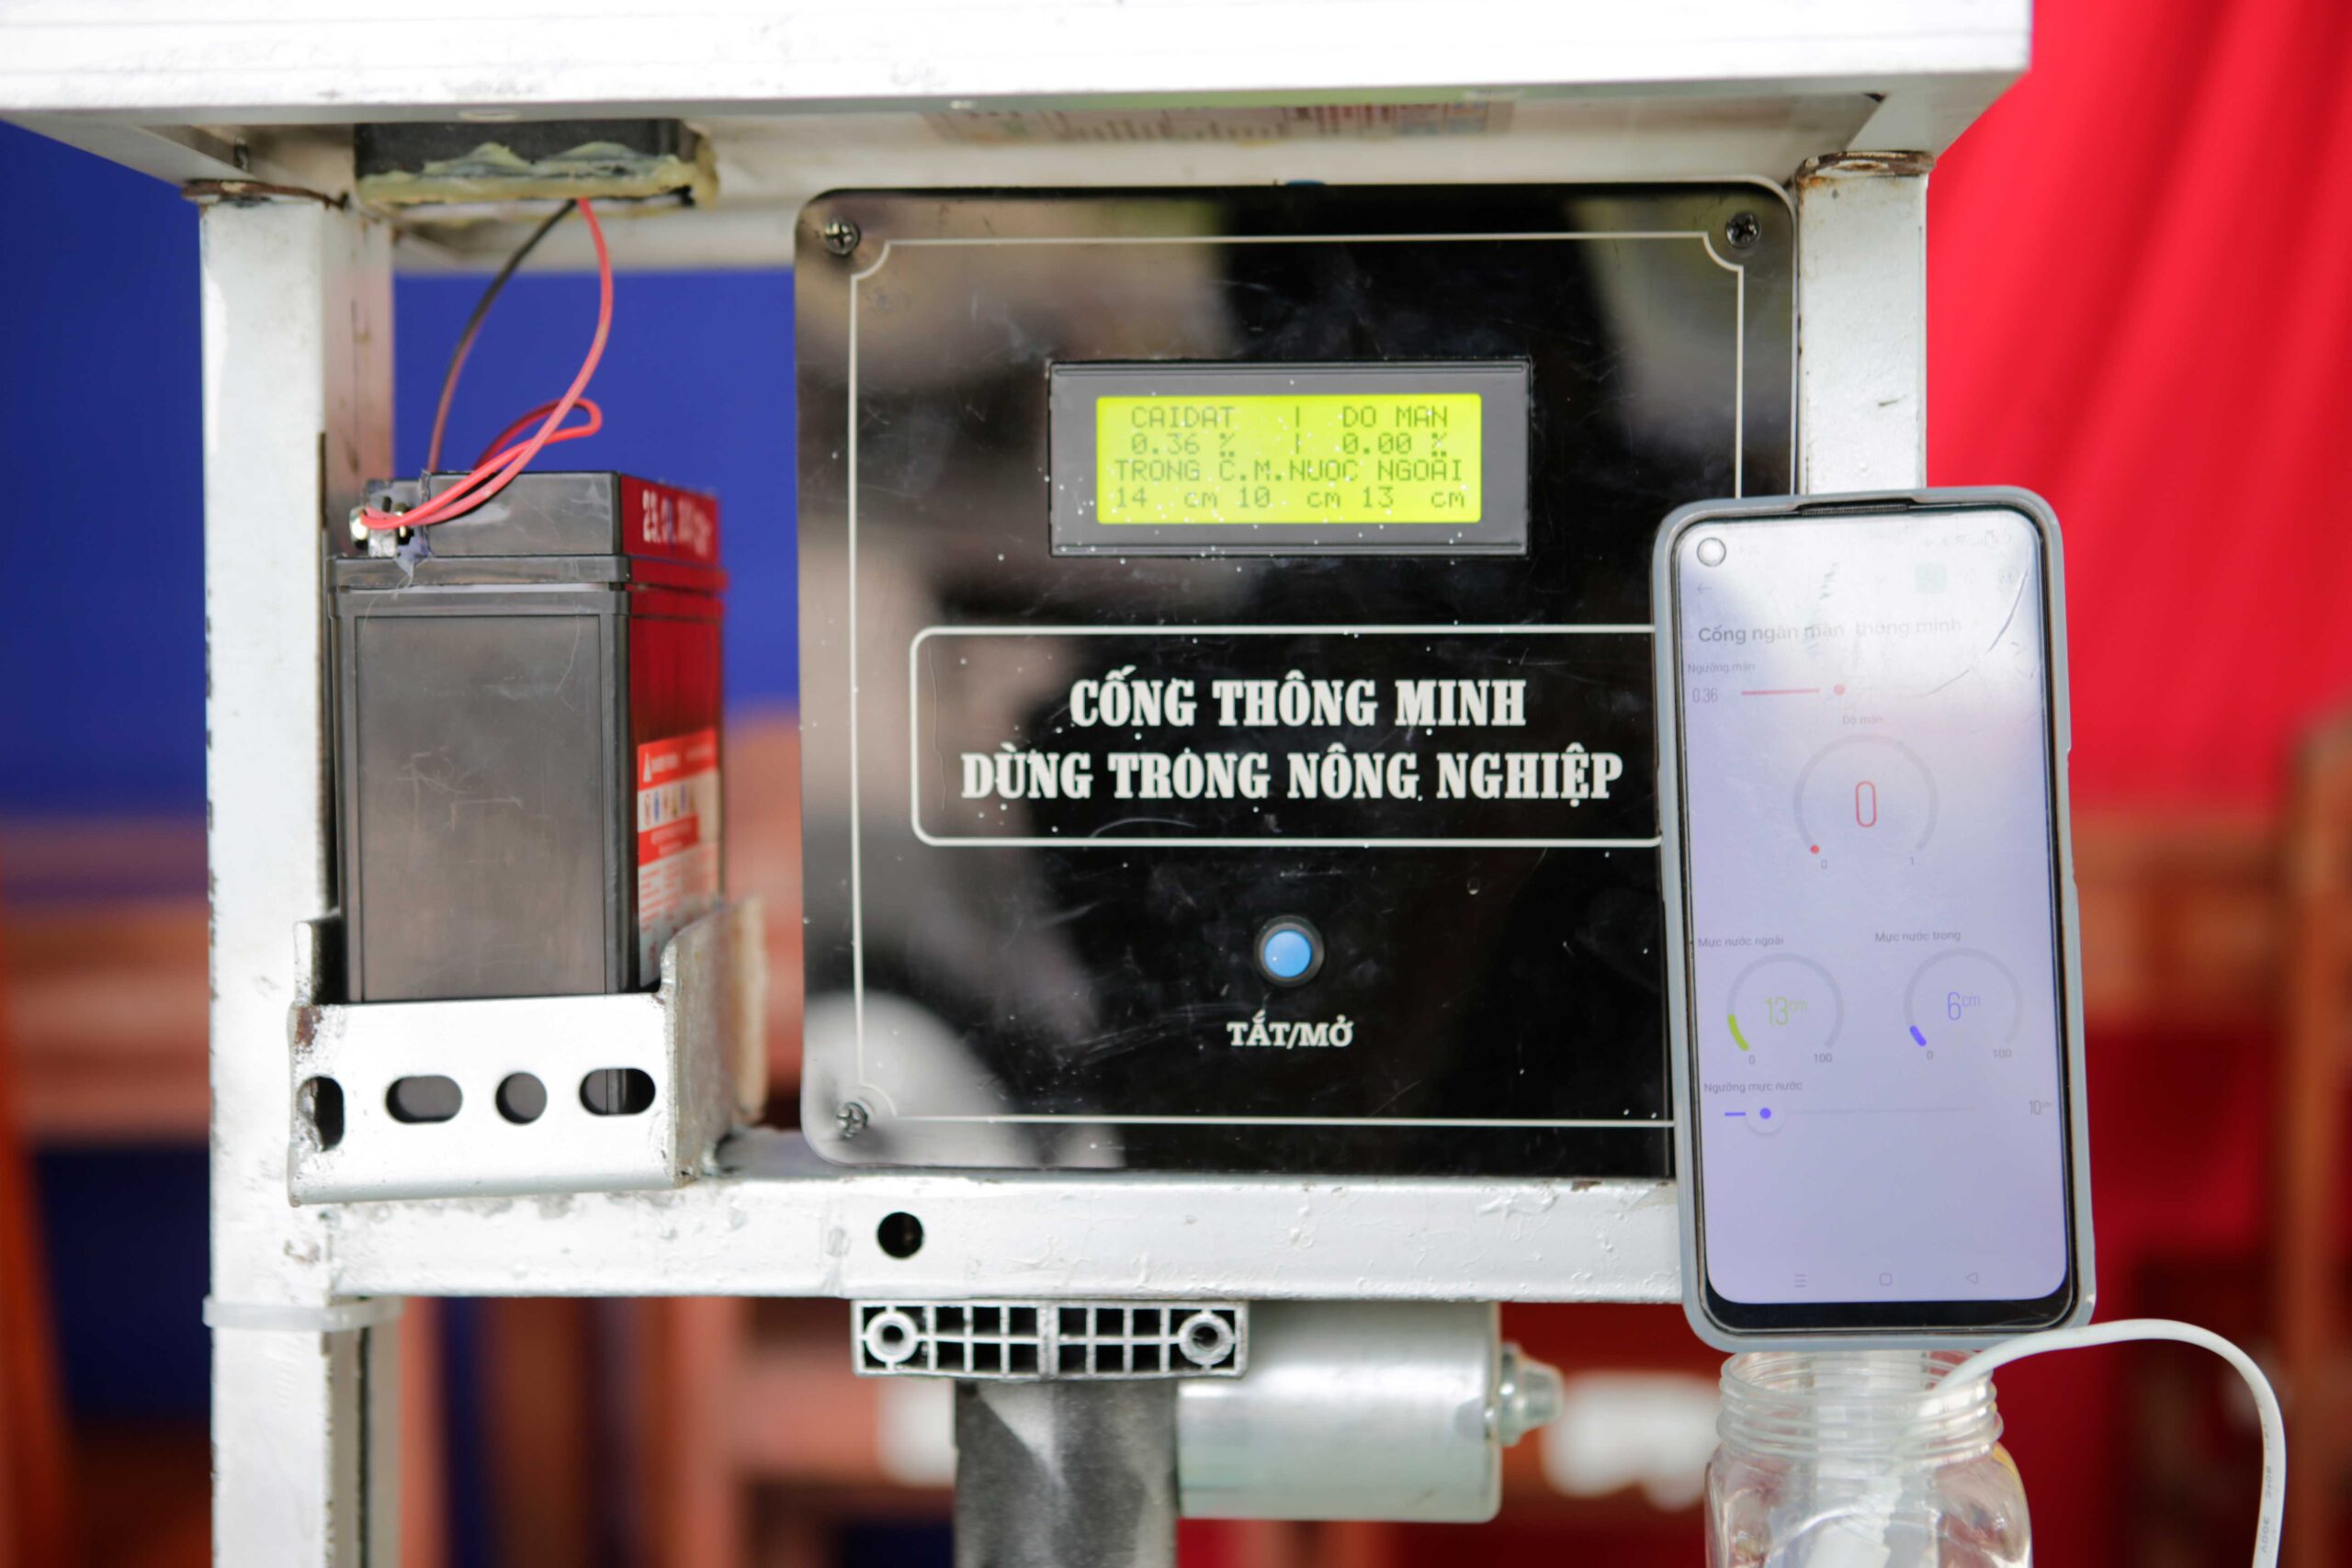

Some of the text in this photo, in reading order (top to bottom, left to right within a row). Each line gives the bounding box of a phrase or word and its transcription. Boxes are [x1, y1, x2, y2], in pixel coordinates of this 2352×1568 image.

[1130, 406, 1236, 429] CAIDAT
[1342, 405, 1377, 428] DO
[1396, 405, 1449, 428] MAN
[1131, 434, 1200, 457] 0.36
[1342, 433, 1412, 456] 0.00
[1114, 460, 1200, 482] TRONG
[1377, 459, 1463, 481] NGOAI
[1115, 487, 1464, 509] 14 cm 10 cm 13 cm
[1698, 625, 1747, 644] Cống
[1069, 664, 1527, 728] CỐNG THÔNG MINH
[1691, 688, 1719, 704] 0.36
[961, 741, 1623, 808] DÙNG TRONG NÔNG NGHIỆP
[1855, 781, 1877, 827] 0
[1932, 931, 1962, 942] trong
[1227, 1010, 1354, 1049] TẮT/MỞ
[1814, 1053, 1833, 1064] 100
[1993, 1048, 2013, 1059] 100
